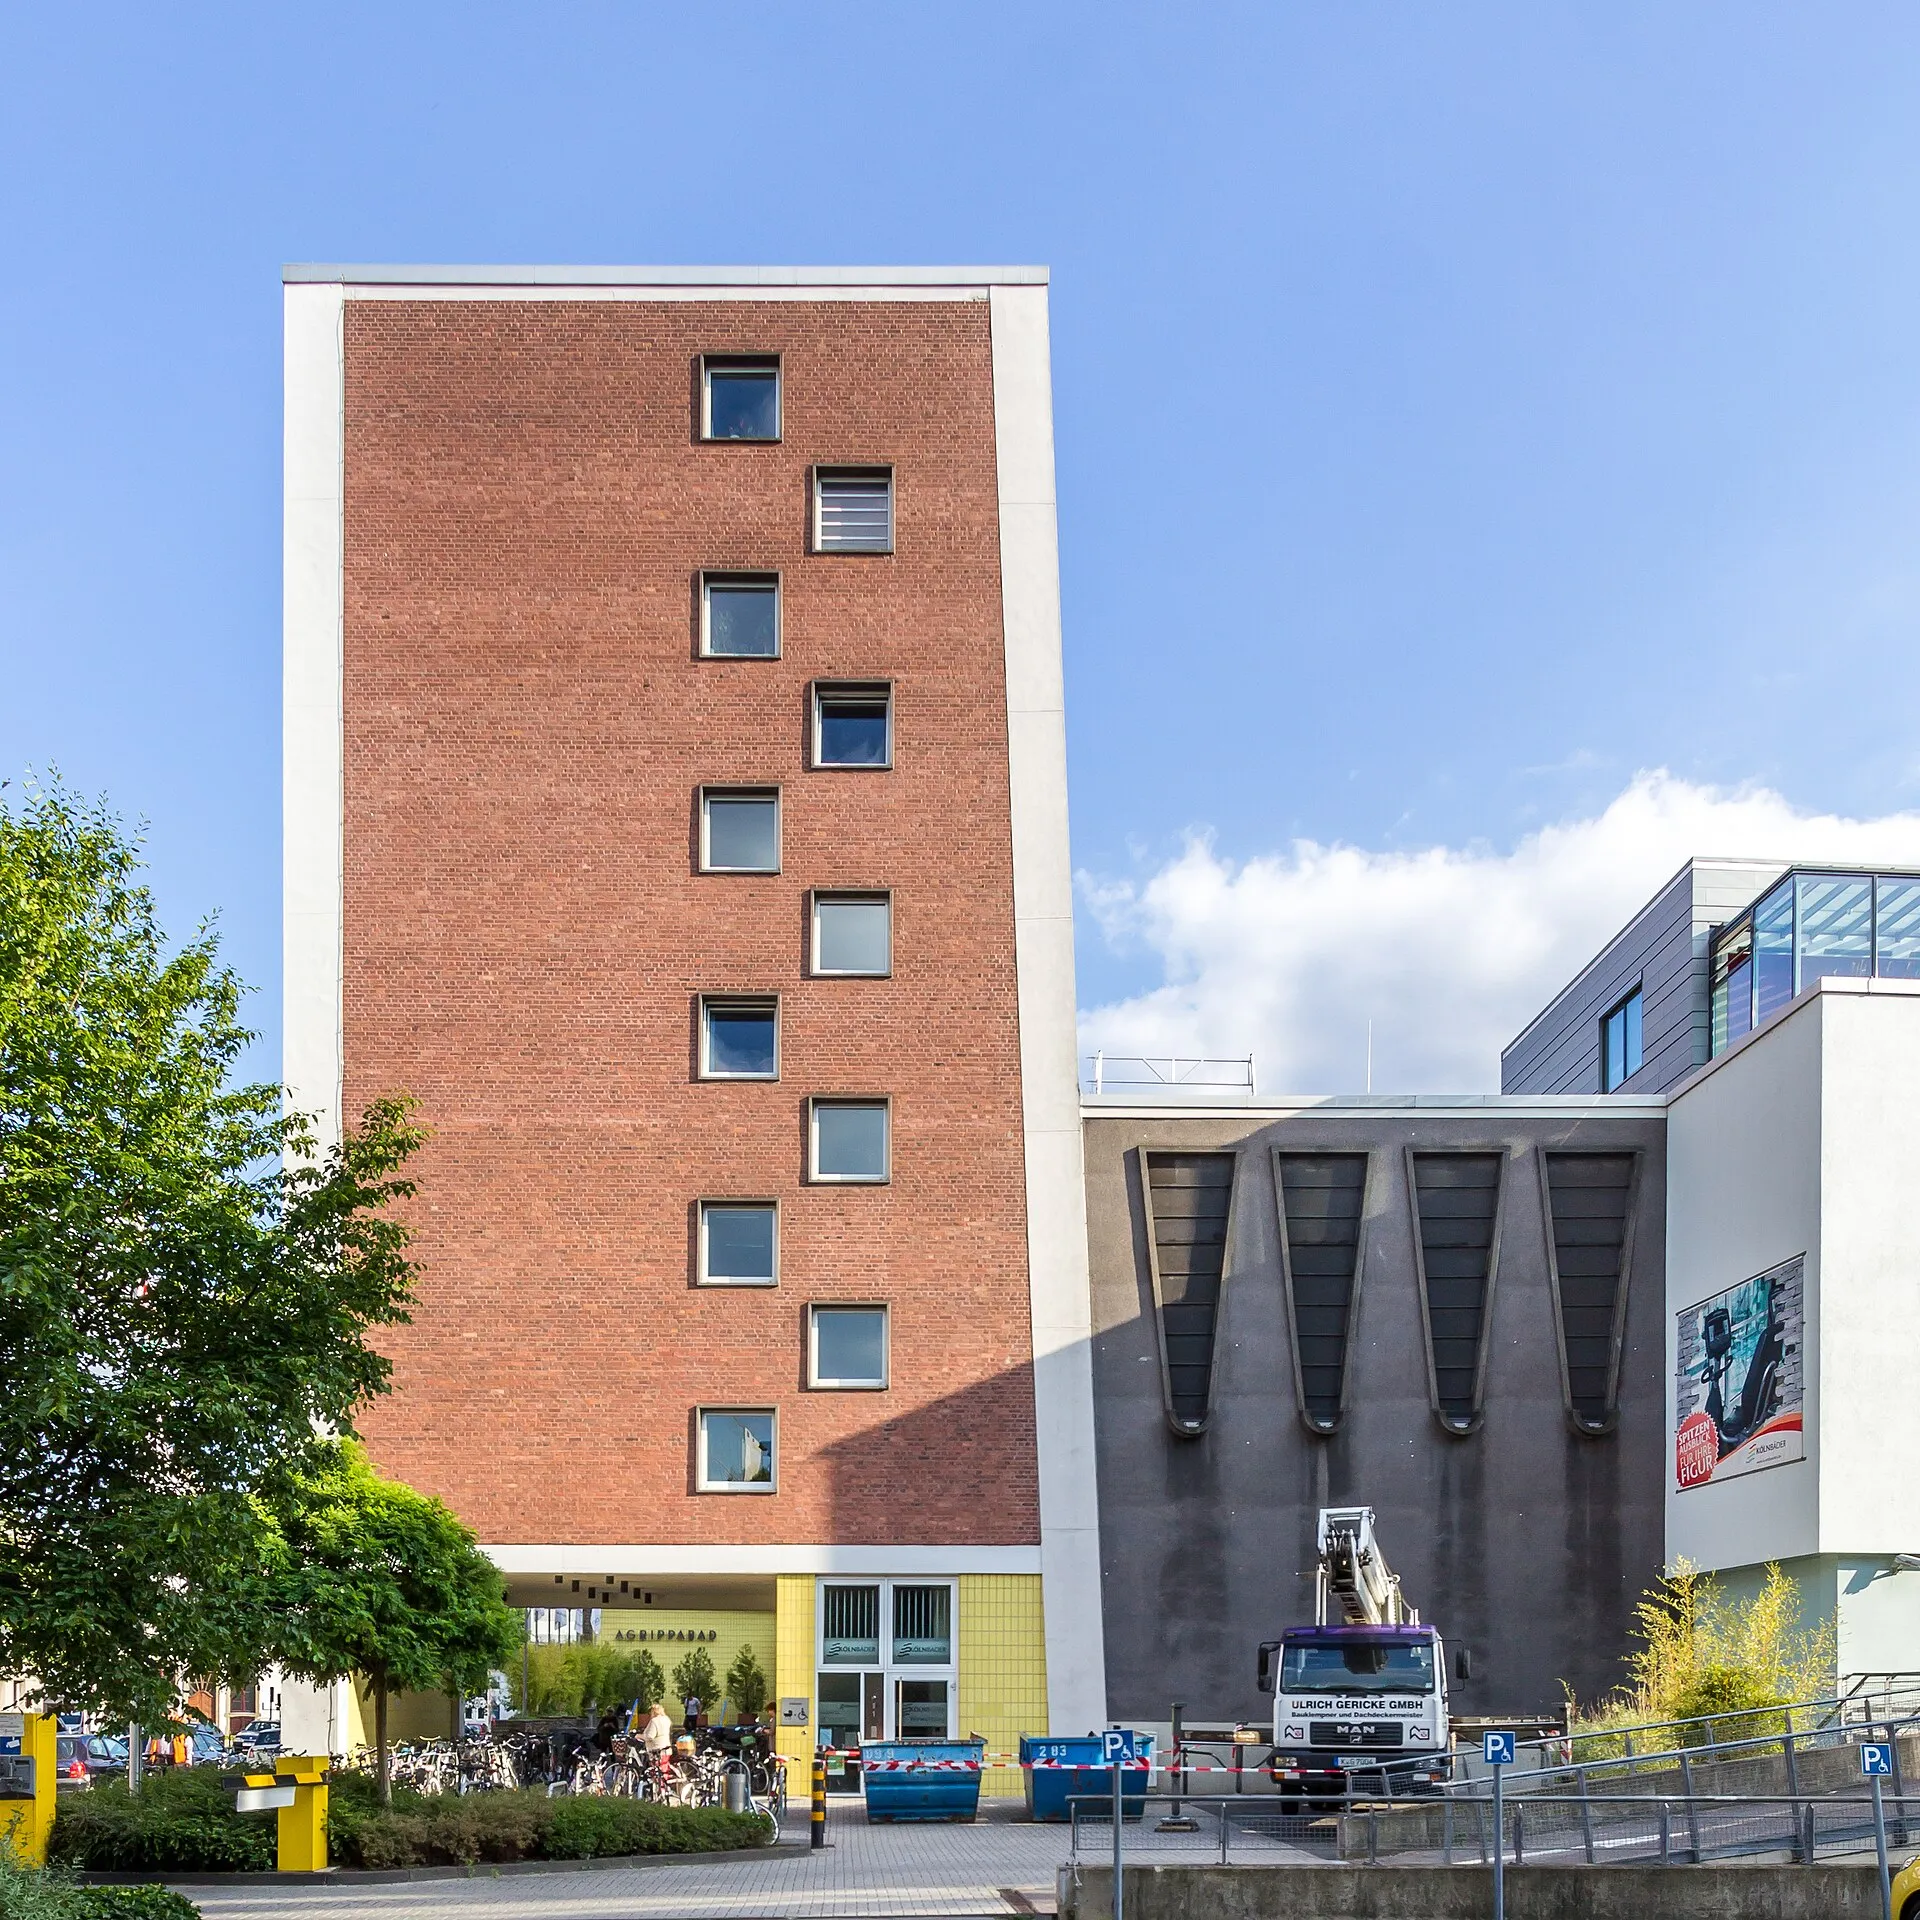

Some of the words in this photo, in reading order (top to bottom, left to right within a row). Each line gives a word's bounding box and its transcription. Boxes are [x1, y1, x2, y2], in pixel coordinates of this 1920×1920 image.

[1678, 1420, 1710, 1446] SPITZEN
[1679, 1431, 1711, 1455] AUSBLICK
[1694, 1442, 1712, 1461] IHRE
[1681, 1454, 1713, 1484] FIGUR
[615, 1629, 717, 1642] AGRIPPABAD
[1291, 1700, 1332, 1709] ULRICH
[1336, 1700, 1386, 1709] GERICKE
[1389, 1700, 1423, 1709] GMBH
[1291, 1711, 1336, 1719] Bauklempner
[1336, 1725, 1376, 1734] MAN
[1105, 1733, 1124, 1759] P
[1487, 1735, 1505, 1760] P
[1864, 1747, 1882, 1771] P
